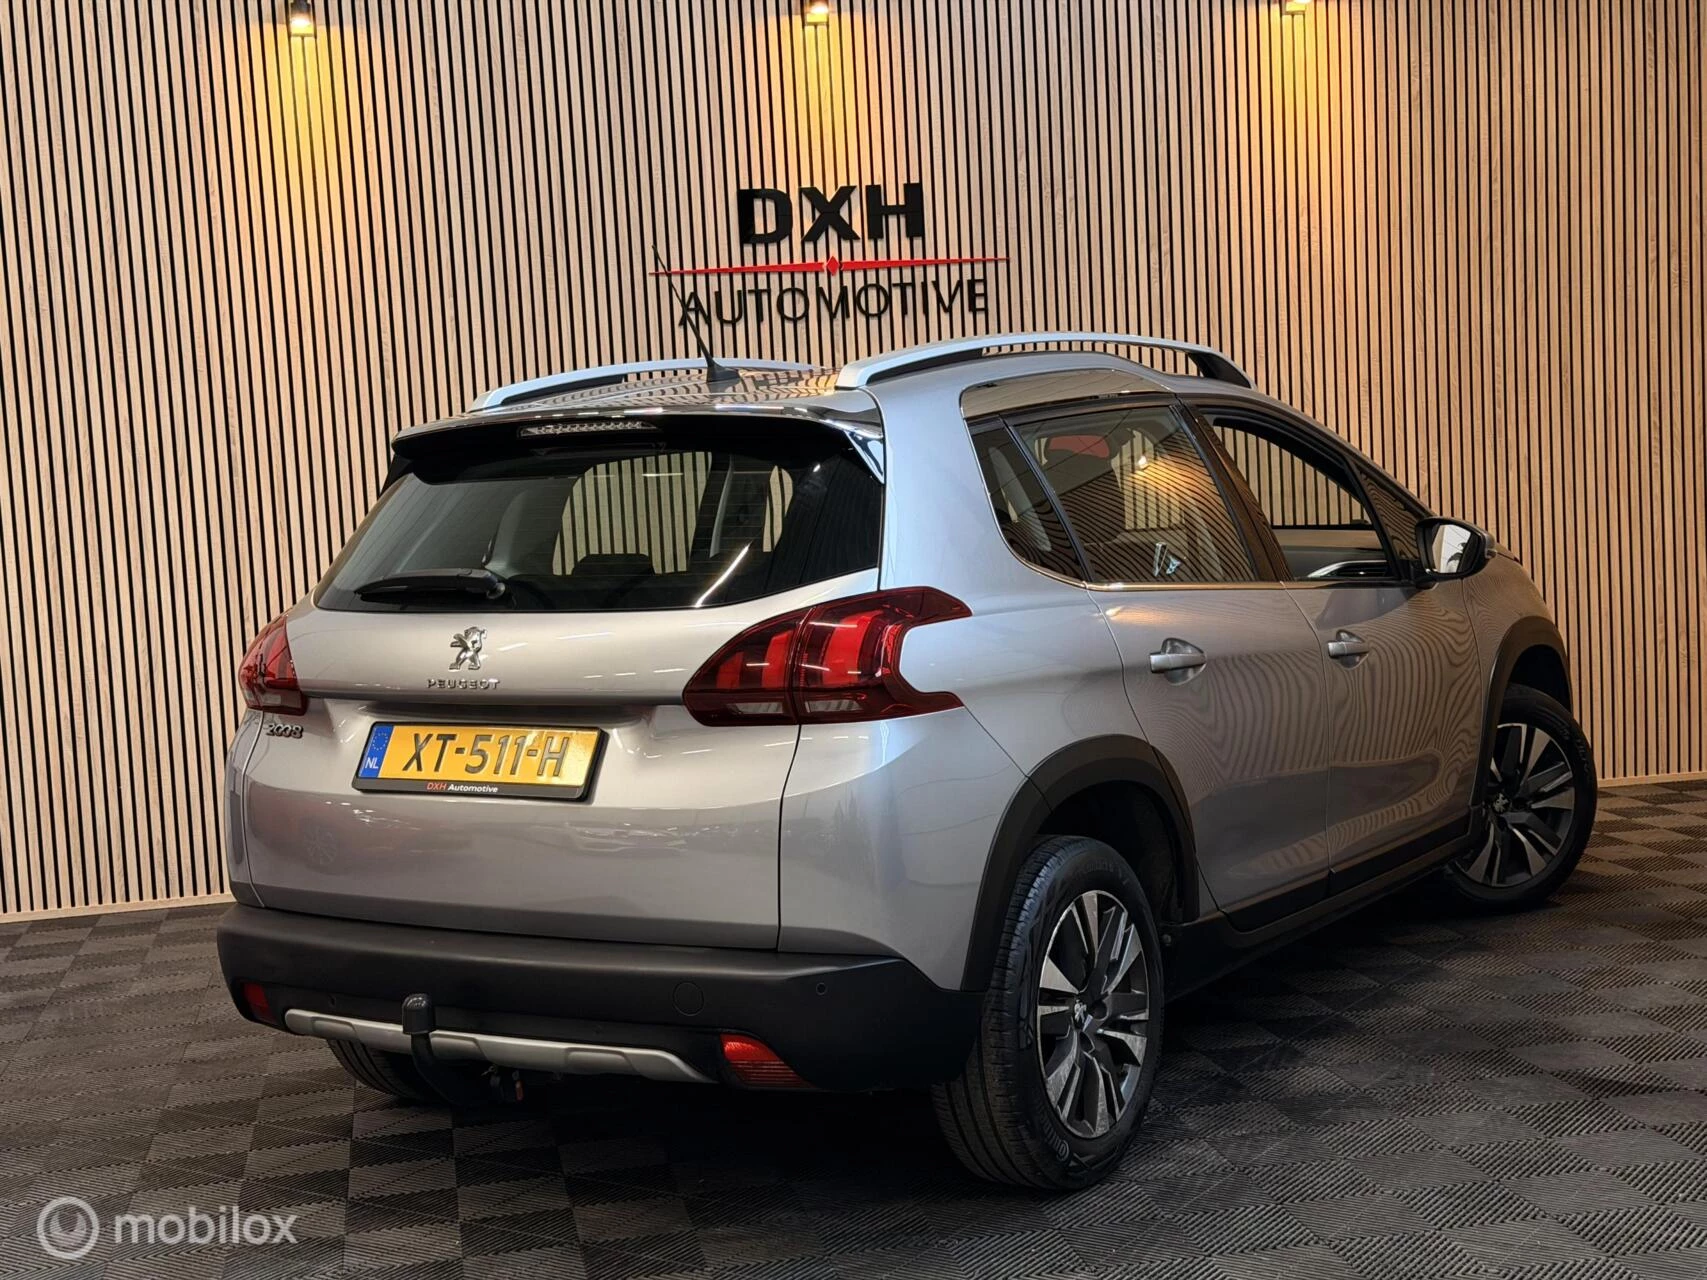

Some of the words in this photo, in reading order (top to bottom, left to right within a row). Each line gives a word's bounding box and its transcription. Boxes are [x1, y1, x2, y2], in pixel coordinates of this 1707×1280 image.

[737, 183, 925, 244] DXH
[678, 278, 989, 327] AUTOMOTIVE
[427, 678, 500, 689] PEUGEOT
[266, 723, 304, 739] 2008
[402, 733, 570, 777] XT-511-H
[365, 757, 379, 770] NL
[426, 782, 447, 791] DXH
[448, 783, 499, 793] Automotive
